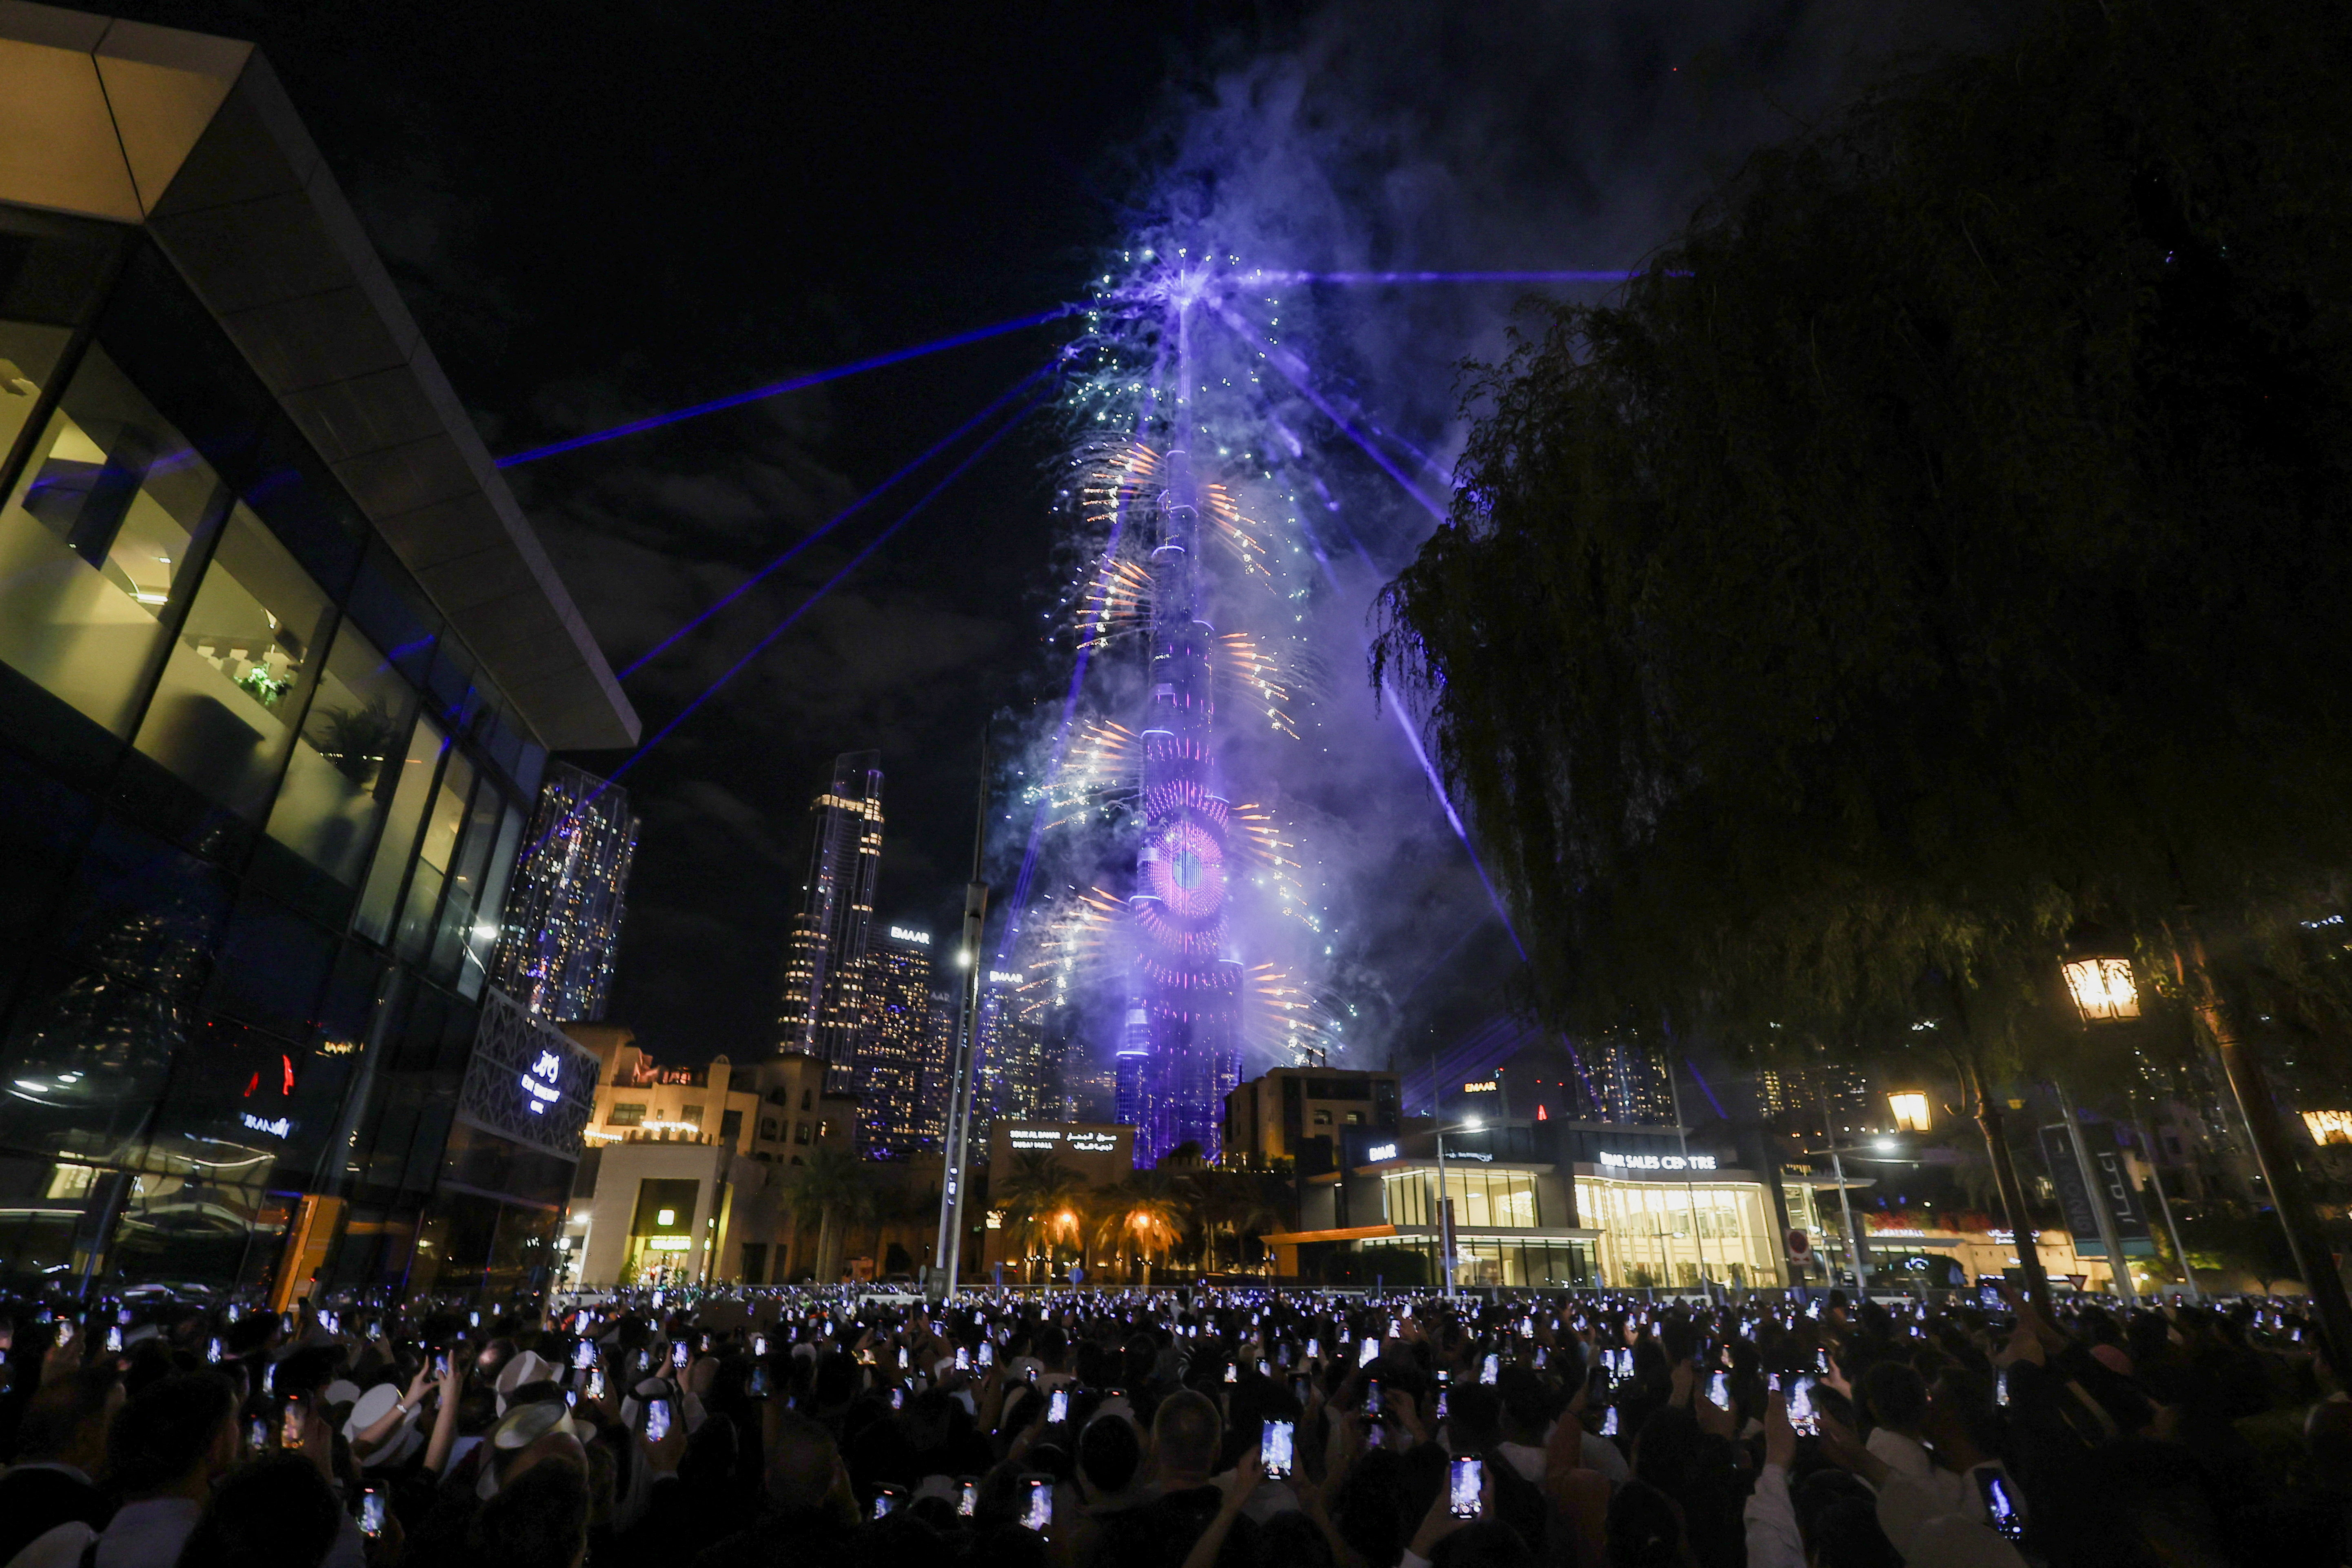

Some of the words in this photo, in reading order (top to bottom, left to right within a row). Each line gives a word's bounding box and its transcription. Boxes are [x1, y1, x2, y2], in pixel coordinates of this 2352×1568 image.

[890, 926, 930, 945] EMAAR
[990, 970, 1024, 984] EMAAR
[1464, 1081, 1497, 1093] EMAAR
[1010, 1130, 1029, 1138] SOUK
[1625, 1155, 1660, 1169] SALES
